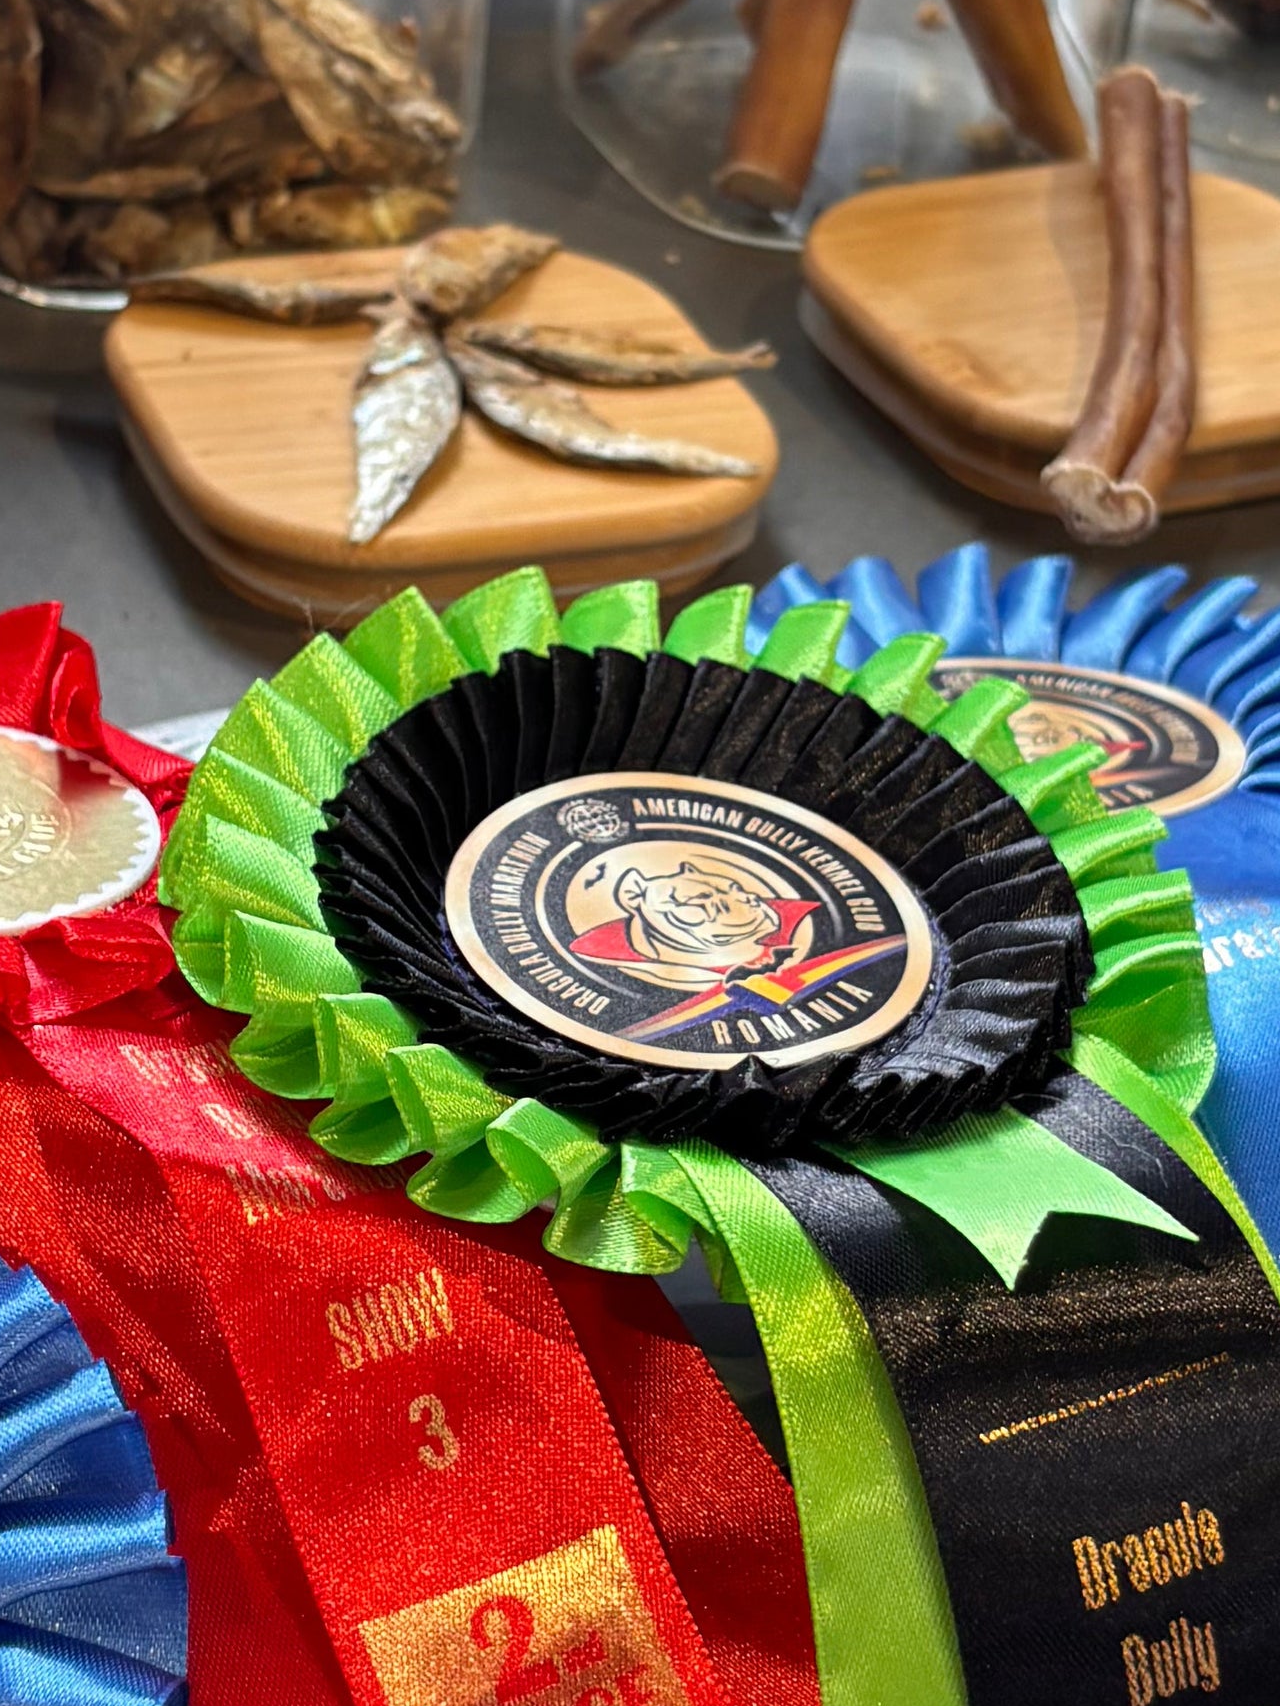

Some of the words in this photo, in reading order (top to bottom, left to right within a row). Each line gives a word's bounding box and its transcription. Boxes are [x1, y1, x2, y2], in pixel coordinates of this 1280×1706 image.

[490, 831, 551, 907] MARATHON
[631, 797, 743, 830] AMERICAN
[744, 816, 809, 854] BULLY
[800, 845, 867, 896] KENNEL
[519, 952, 611, 1016] DRACULA
[711, 980, 874, 1045] ROMÂNIA
[407, 1393, 461, 1472] 3
[1071, 1500, 1226, 1612] Dracula
